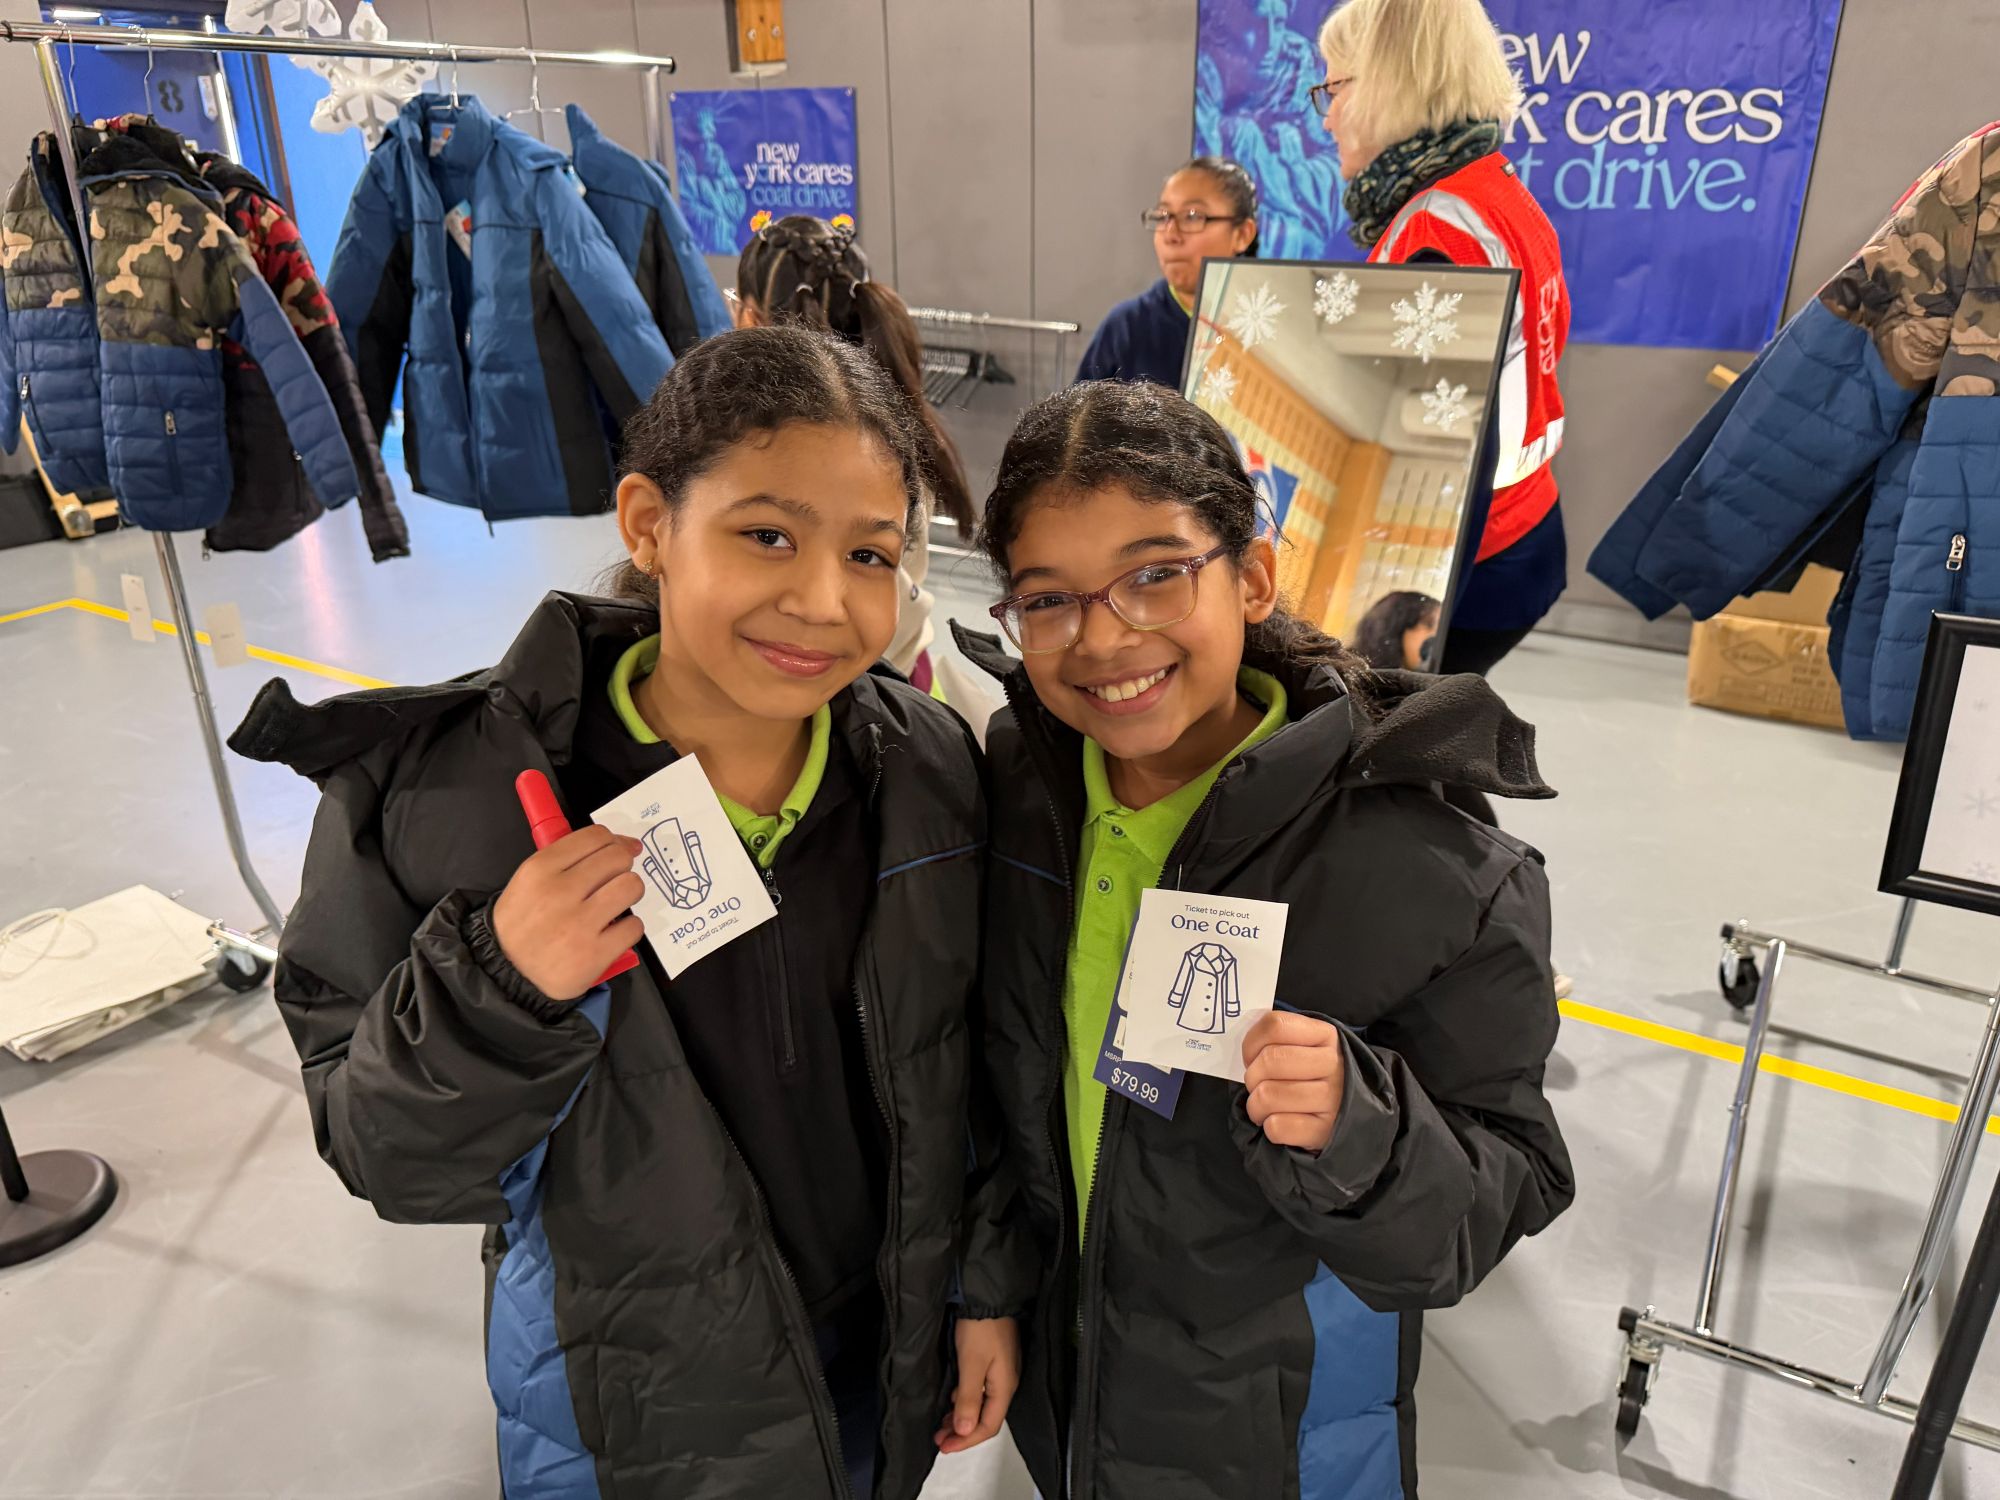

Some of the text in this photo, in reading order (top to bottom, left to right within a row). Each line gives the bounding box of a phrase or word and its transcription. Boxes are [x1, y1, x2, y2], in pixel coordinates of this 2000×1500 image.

[1498, 30, 1591, 85] ew
[157, 79, 184, 113] 8
[1564, 88, 1784, 145] cares
[756, 142, 800, 163] new
[743, 160, 854, 190] york cares
[1553, 140, 1757, 212] drive.
[751, 185, 851, 209] coat drive.
[669, 896, 741, 944] One Coat
[1171, 914, 1260, 940] One Coat
[1184, 904, 1209, 914] Ticket
[1219, 909, 1235, 918] pick
[1236, 912, 1250, 920] out
[1111, 1067, 1159, 1104] $79.99
